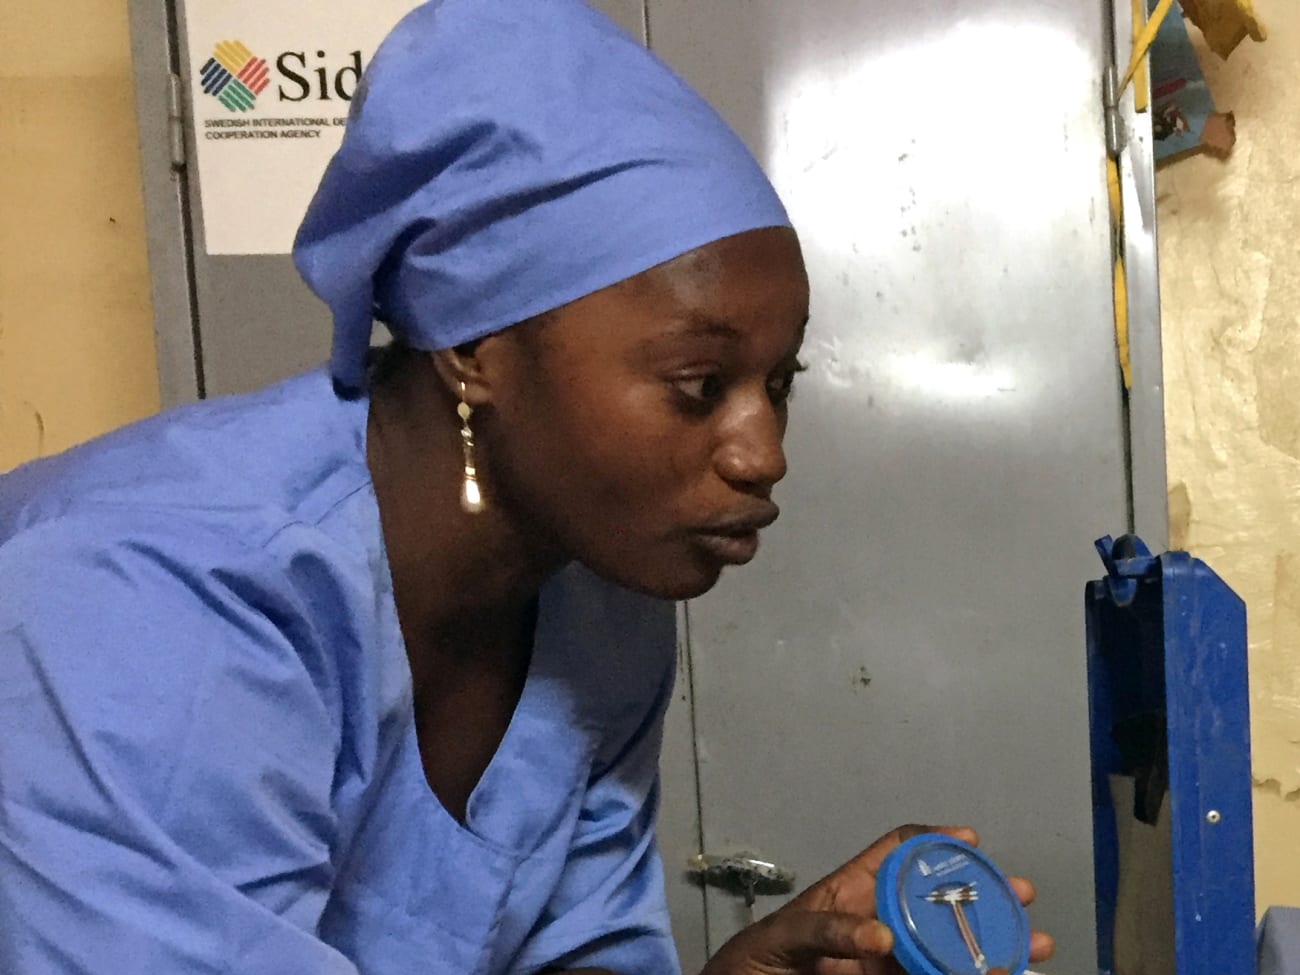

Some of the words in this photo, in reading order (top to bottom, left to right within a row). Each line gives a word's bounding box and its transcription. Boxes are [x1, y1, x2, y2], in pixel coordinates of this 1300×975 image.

[204, 119, 250, 128] SWEDISH
[252, 118, 329, 127] INTERNATIONAL
[205, 131, 278, 140] COOPERATION
[280, 130, 321, 139] AGENCY
